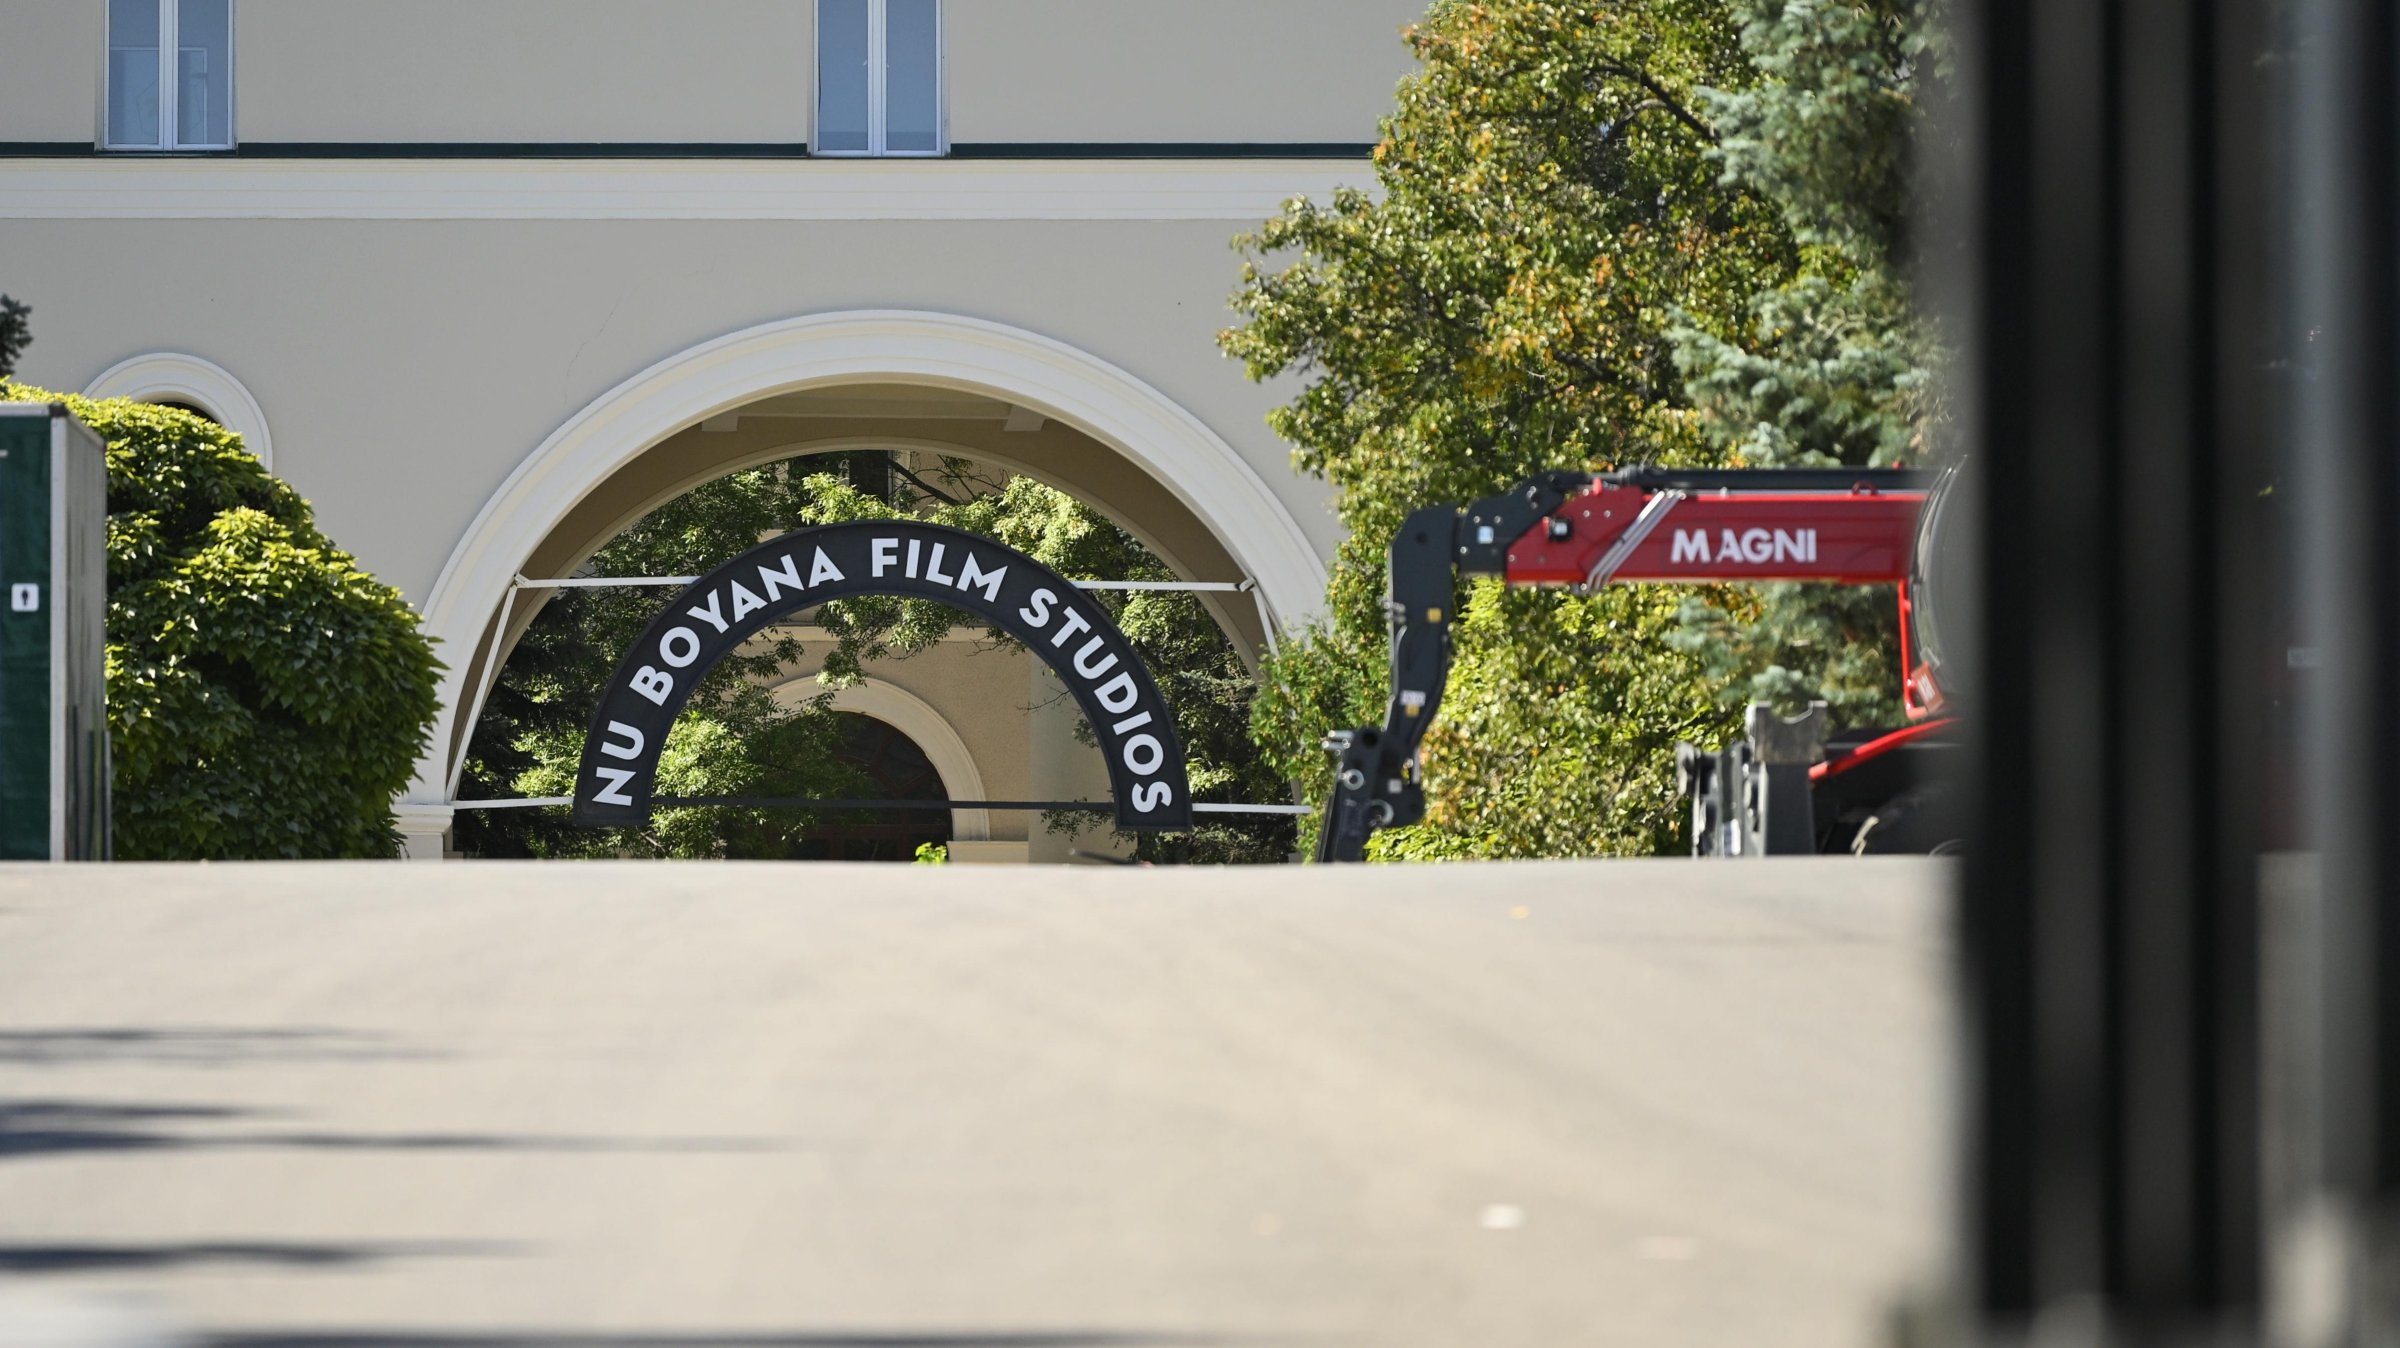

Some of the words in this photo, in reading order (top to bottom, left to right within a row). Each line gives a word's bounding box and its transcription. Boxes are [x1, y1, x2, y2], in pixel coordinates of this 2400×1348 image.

[1671, 528, 1817, 564] MAGNI
[592, 720, 645, 806] NU
[629, 545, 845, 706] BOYANA
[871, 537, 1009, 603] FILM
[1019, 588, 1173, 814] STUDIOS
